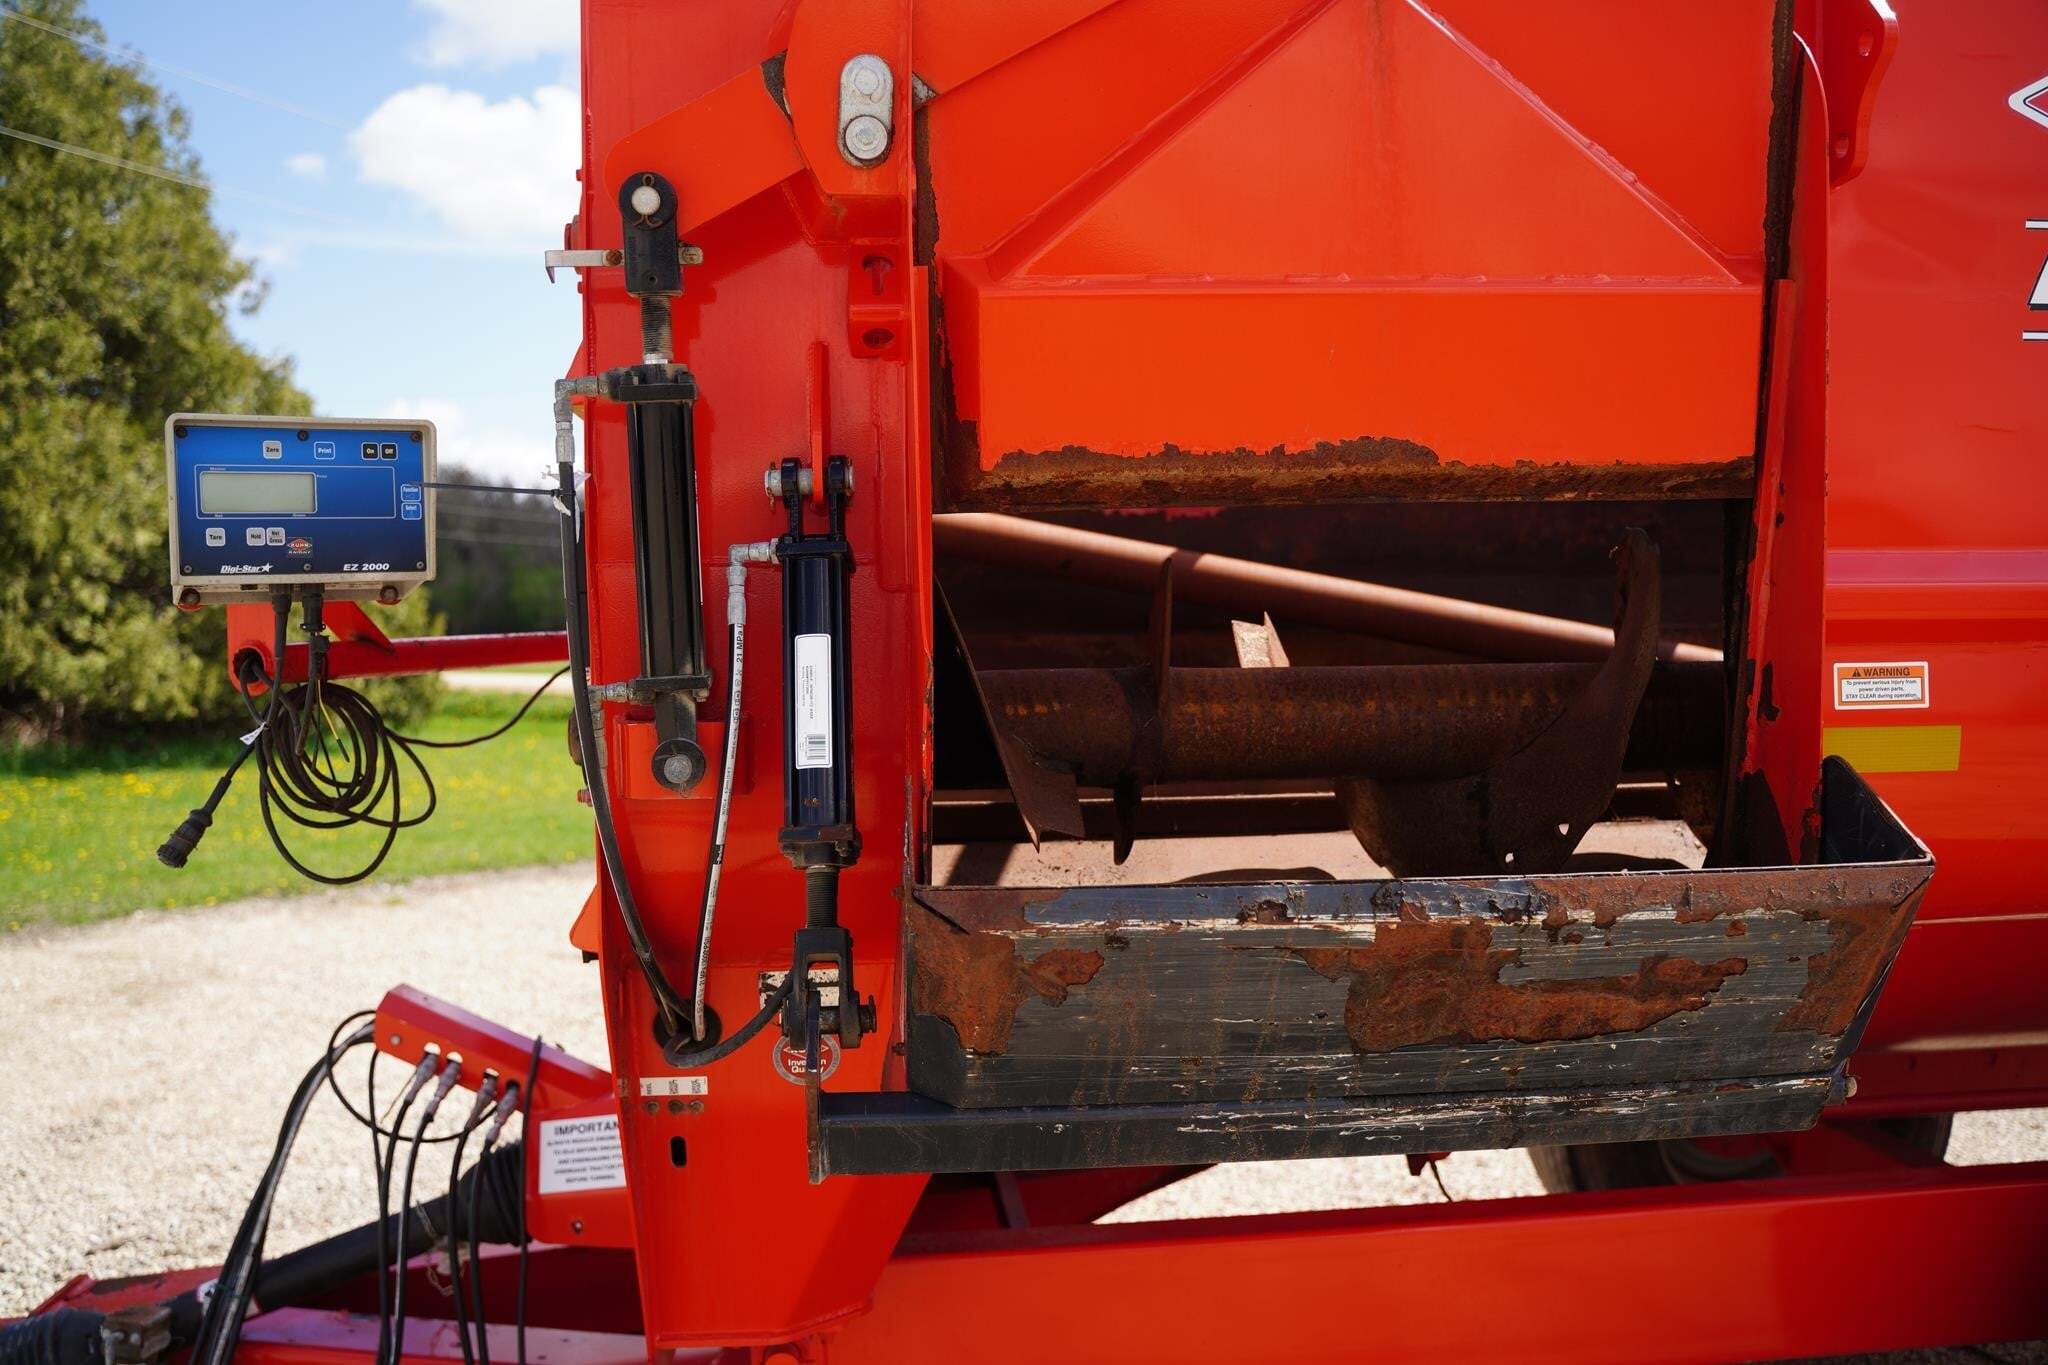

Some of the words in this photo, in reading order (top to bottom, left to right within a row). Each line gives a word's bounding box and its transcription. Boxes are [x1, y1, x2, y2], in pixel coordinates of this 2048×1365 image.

[317, 447, 332, 455] Print
[220, 564, 260, 574] Digi-Star
[343, 563, 359, 571] EZ
[362, 563, 390, 571] 2000
[736, 630, 744, 650] MPa
[736, 653, 743, 663] 21
[1863, 667, 1911, 677] WARNING
[554, 1121, 618, 1135] IMPORTAN
